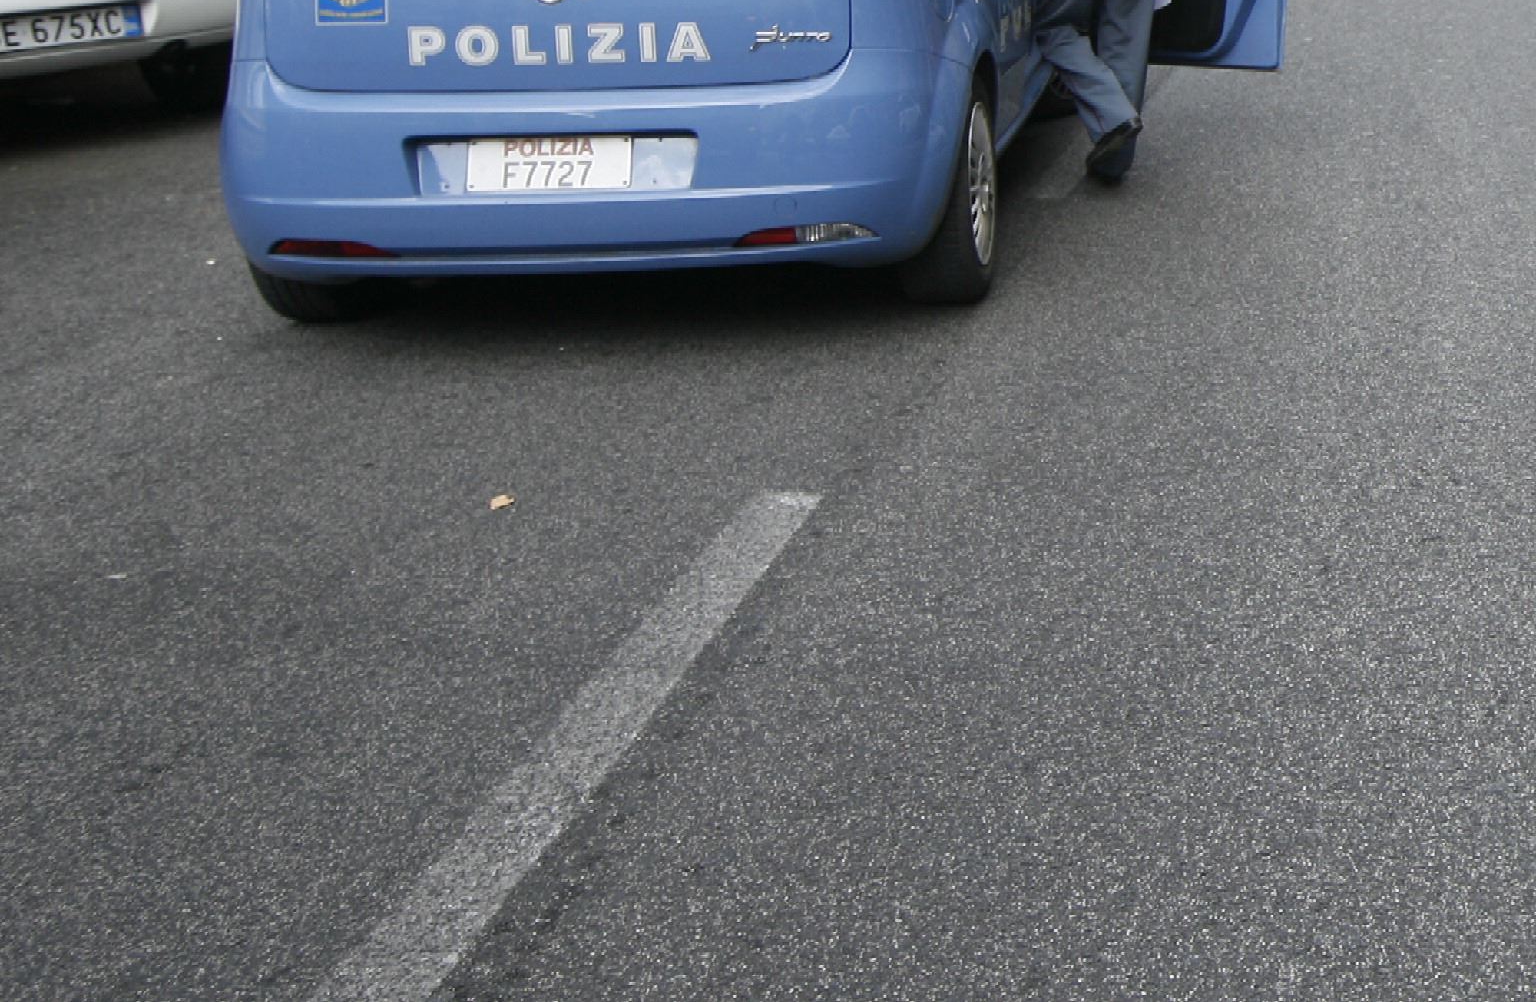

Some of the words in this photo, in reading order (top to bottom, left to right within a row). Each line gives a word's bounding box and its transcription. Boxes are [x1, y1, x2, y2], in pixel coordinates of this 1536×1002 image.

[31, 9, 121, 44] 675XC
[407, 22, 711, 66] POLIZIA
[504, 138, 594, 158] POLIZIA
[503, 160, 593, 189] F7727
